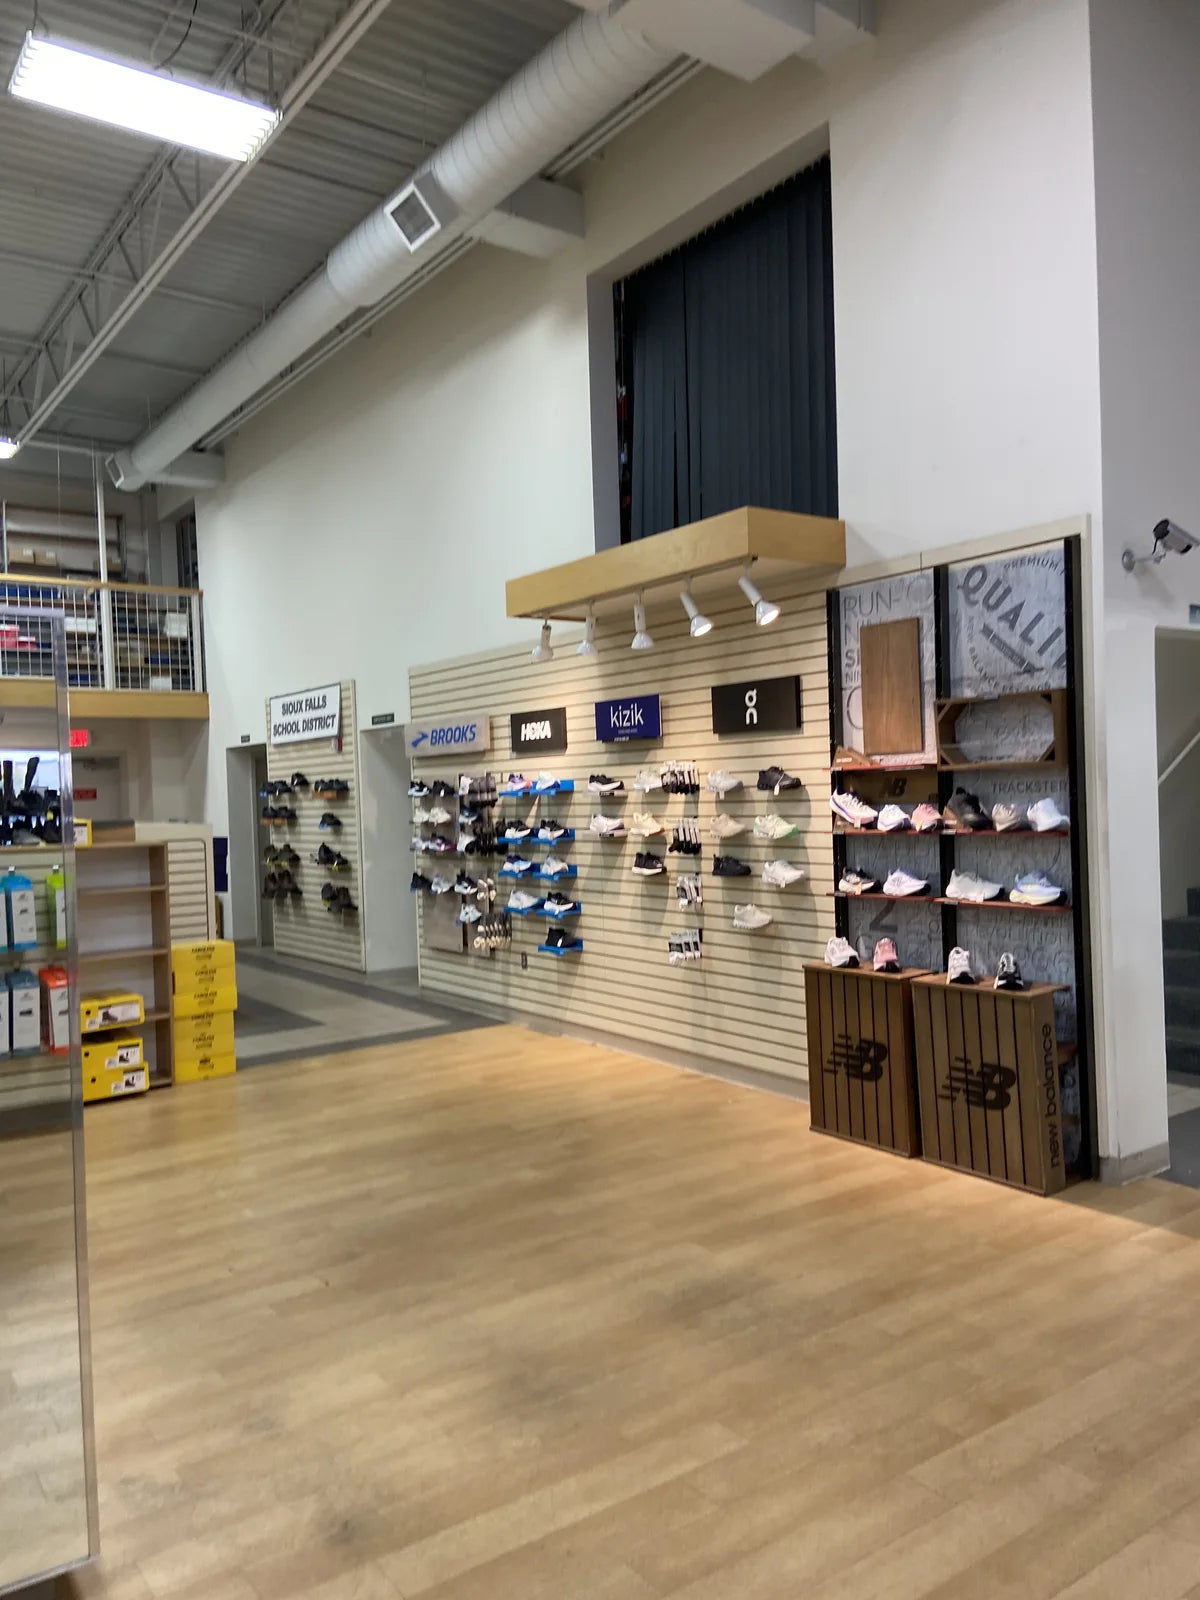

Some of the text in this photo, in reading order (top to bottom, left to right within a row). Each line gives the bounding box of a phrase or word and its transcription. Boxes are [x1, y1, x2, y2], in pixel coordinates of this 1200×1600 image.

[281, 695, 327, 716] SIOUX FALLS
[610, 702, 644, 728] kizik
[273, 714, 336, 736] SCHOOL DISTRICT
[430, 724, 476, 745] BROOKS
[521, 720, 551, 741] HOKA
[1042, 1023, 1059, 1168] new balance
